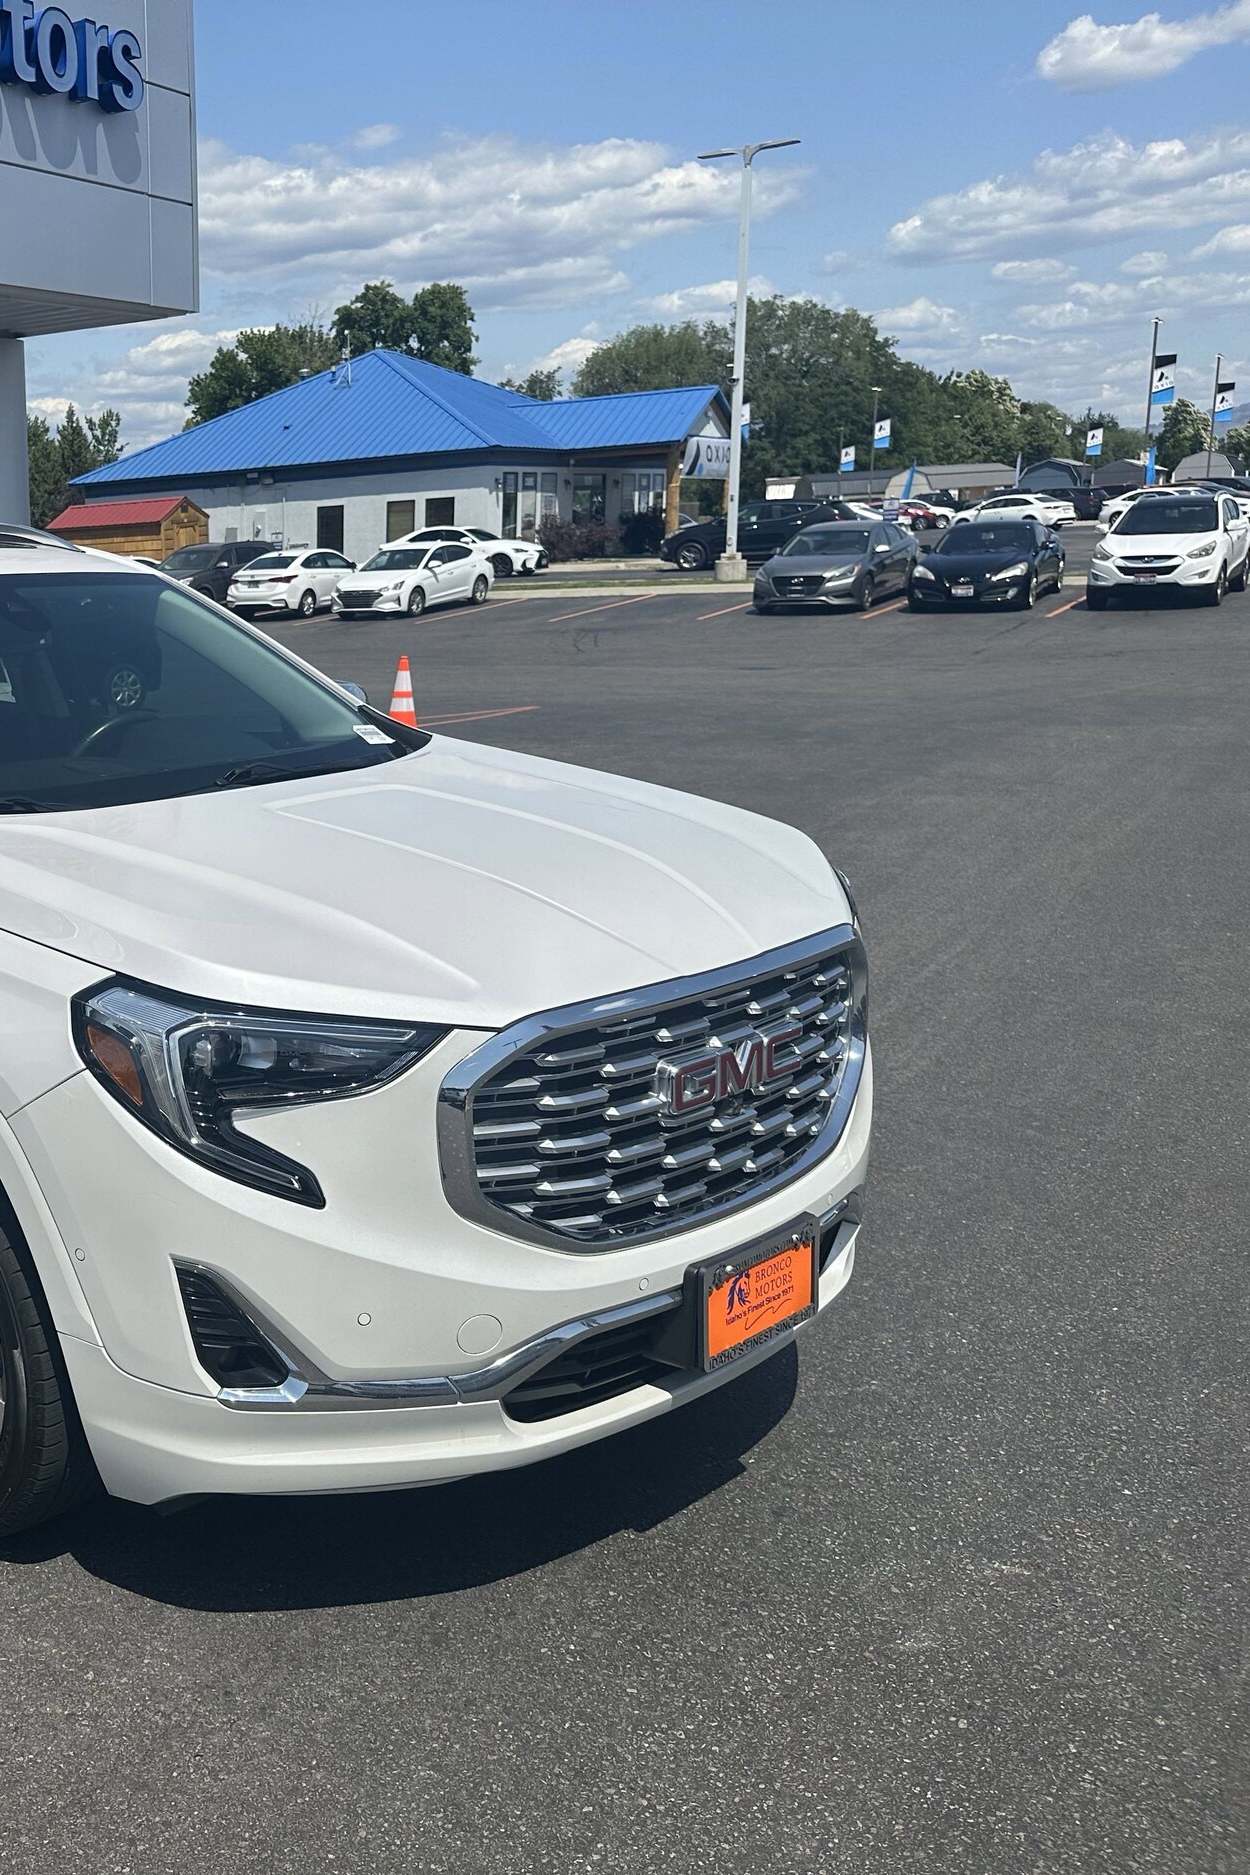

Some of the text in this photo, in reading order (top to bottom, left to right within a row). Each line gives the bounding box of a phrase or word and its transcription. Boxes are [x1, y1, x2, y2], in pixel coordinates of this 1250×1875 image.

[670, 1022, 804, 1115] GMC
[755, 1256, 792, 1283] BRONCO
[755, 1271, 793, 1299] MOTORS
[726, 1285, 794, 1326] Idaho's Finest Since 1971
[743, 1327, 775, 1351] FINEST
[774, 1316, 799, 1336] SINCE
